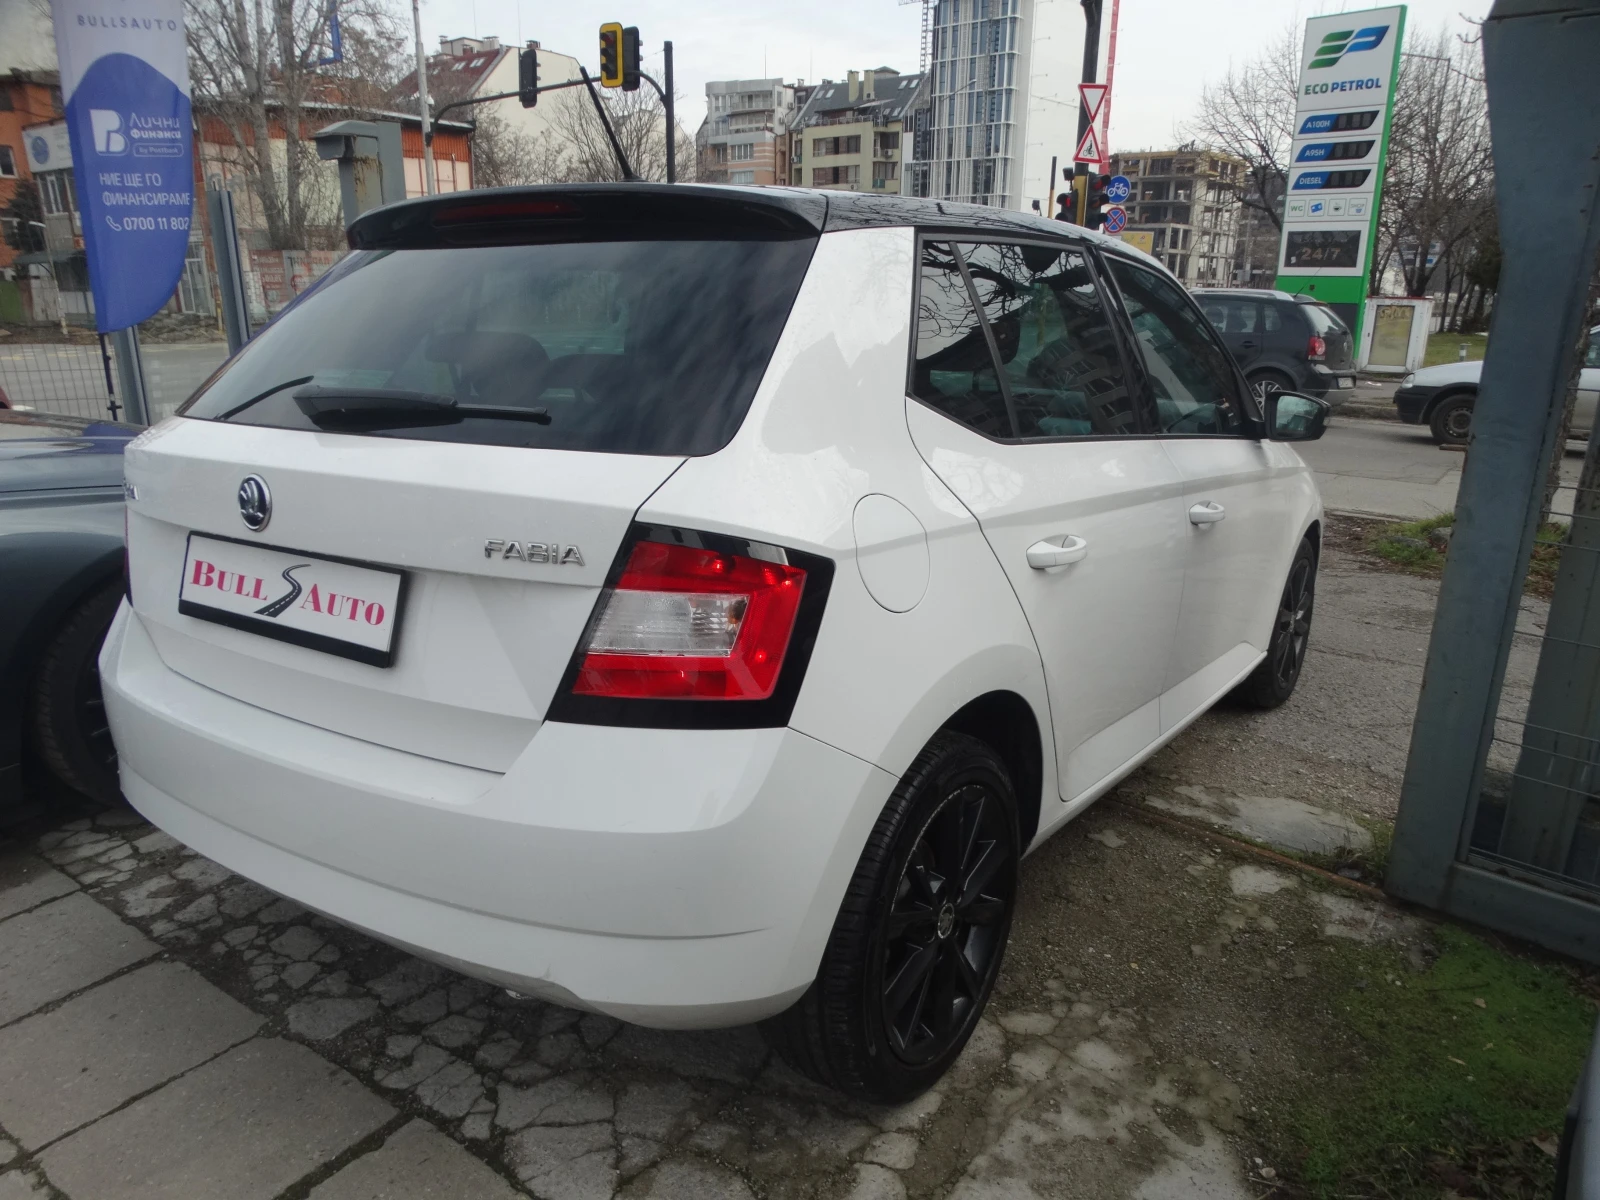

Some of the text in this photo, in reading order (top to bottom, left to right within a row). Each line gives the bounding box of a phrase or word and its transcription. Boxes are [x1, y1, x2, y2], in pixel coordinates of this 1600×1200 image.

[77, 14, 177, 31] BULLSAUTO
[129, 112, 180, 128] Лични
[130, 129, 182, 139] Финанси
[99, 172, 162, 188] НИЕ ЩЕ ГО
[1299, 177, 1322, 185] DIESEL
[102, 191, 190, 207] ФИНАНСИРАМЕ
[123, 217, 190, 231] 0700 11 802
[1301, 246, 1340, 261] 24/7
[484, 538, 585, 567] FABIA
